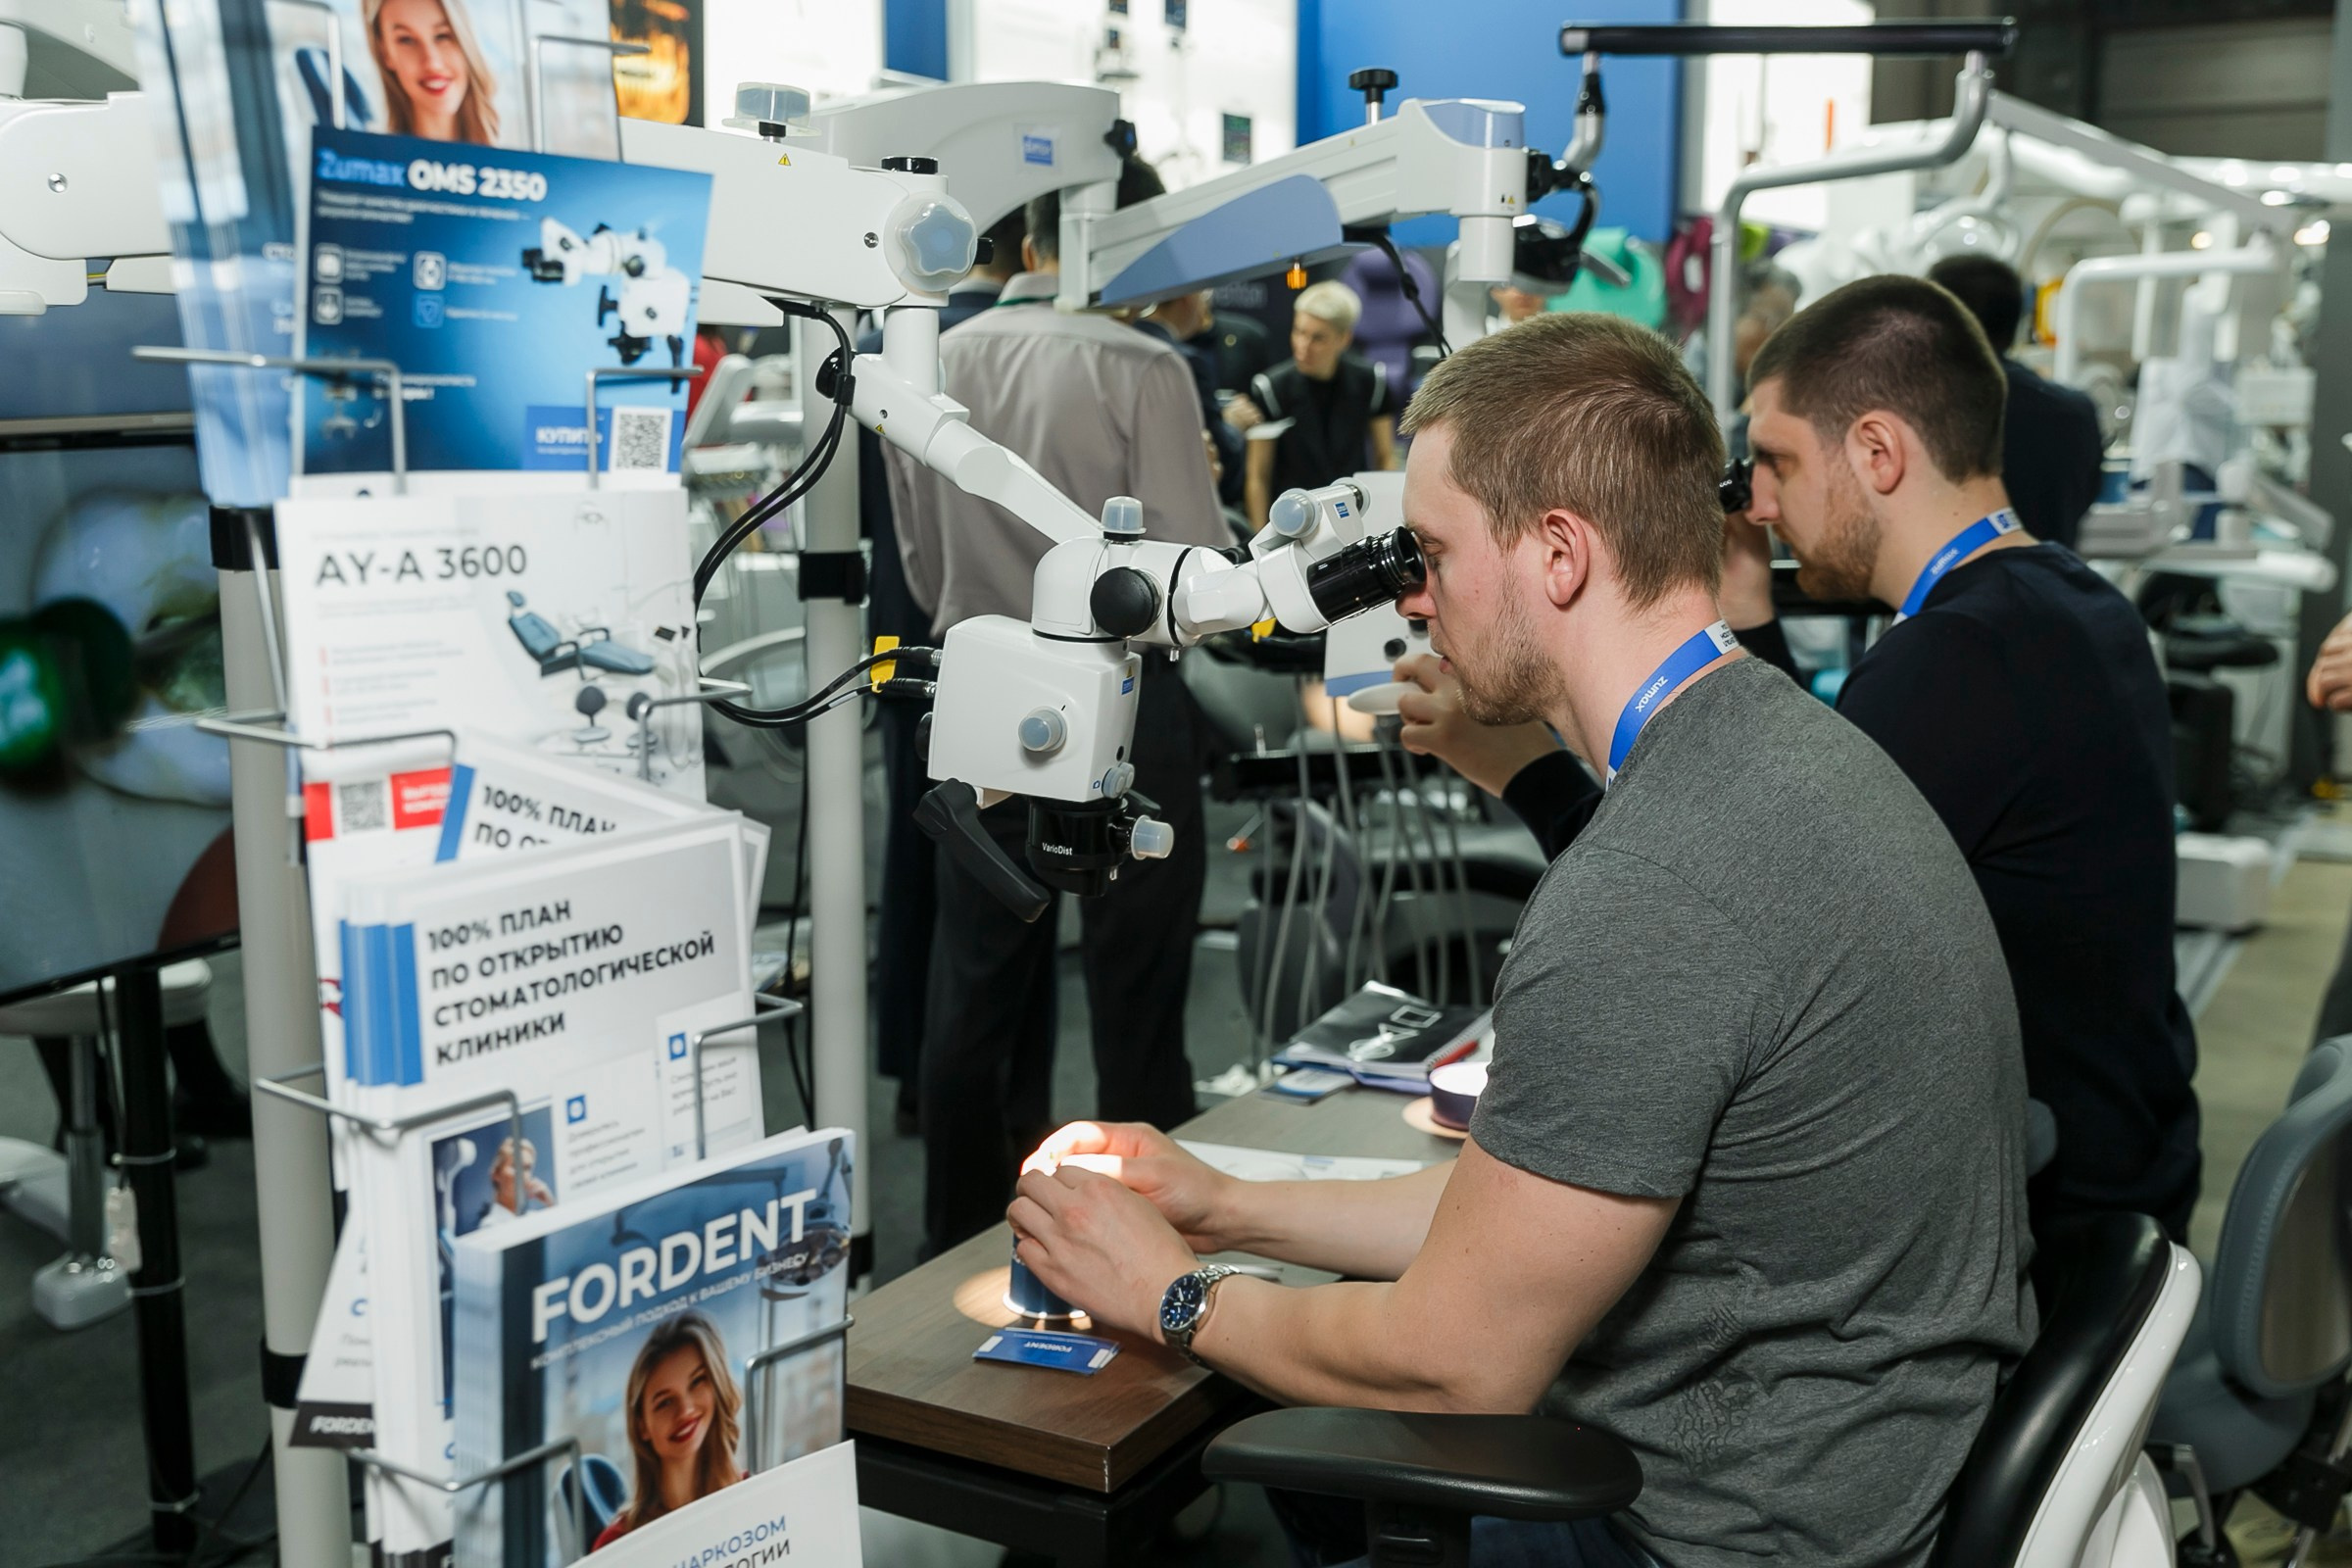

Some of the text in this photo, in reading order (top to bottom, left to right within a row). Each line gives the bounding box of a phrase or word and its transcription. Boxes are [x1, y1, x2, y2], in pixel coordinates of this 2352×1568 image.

[408, 159, 477, 195] OMS
[478, 166, 548, 202] 2350
[317, 544, 527, 586] AY-A 3600
[1635, 675, 1669, 712] zumax
[484, 784, 541, 821] 100%
[475, 822, 512, 849] ПО
[1042, 842, 1073, 856] VarioDist
[428, 900, 571, 953] 100% ПЛАН
[431, 924, 624, 991] ПО ОТКРЫТИЮ
[434, 929, 715, 1028] СТОМАТОЛОГИЧЕСКОЙ
[435, 1011, 565, 1067] КЛИНИКИ
[532, 1187, 817, 1345] FORDENT
